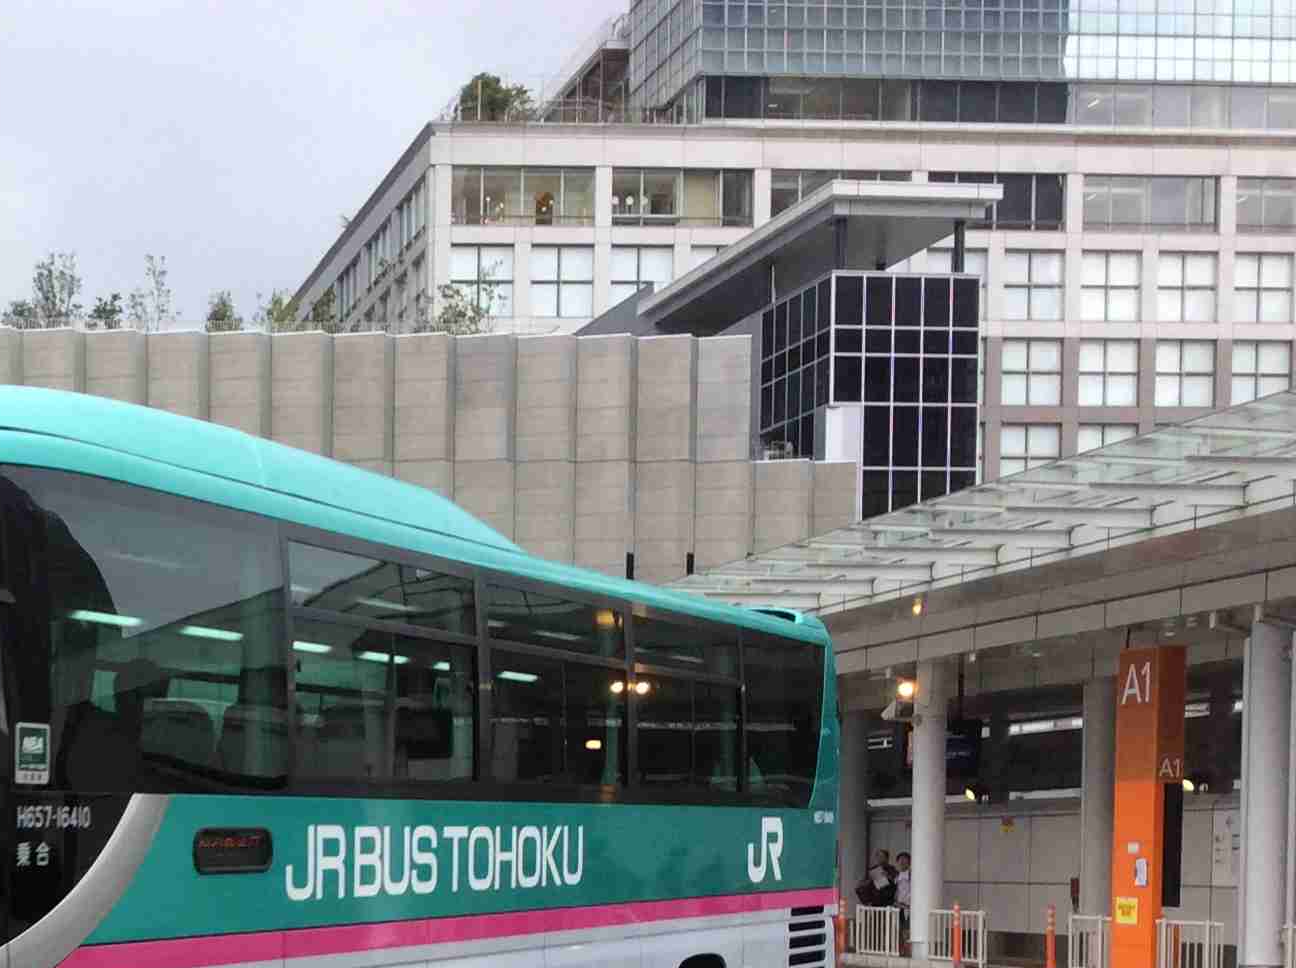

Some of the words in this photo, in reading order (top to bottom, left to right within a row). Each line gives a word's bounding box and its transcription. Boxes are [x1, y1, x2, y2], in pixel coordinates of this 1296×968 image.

[1121, 661, 1151, 704] A1
[1159, 758, 1180, 777] A1
[16, 805, 91, 828] H657-16410
[285, 824, 346, 900] JR
[353, 826, 439, 899] BUS
[443, 824, 584, 893] TOHOKU
[747, 816, 784, 883] JR
